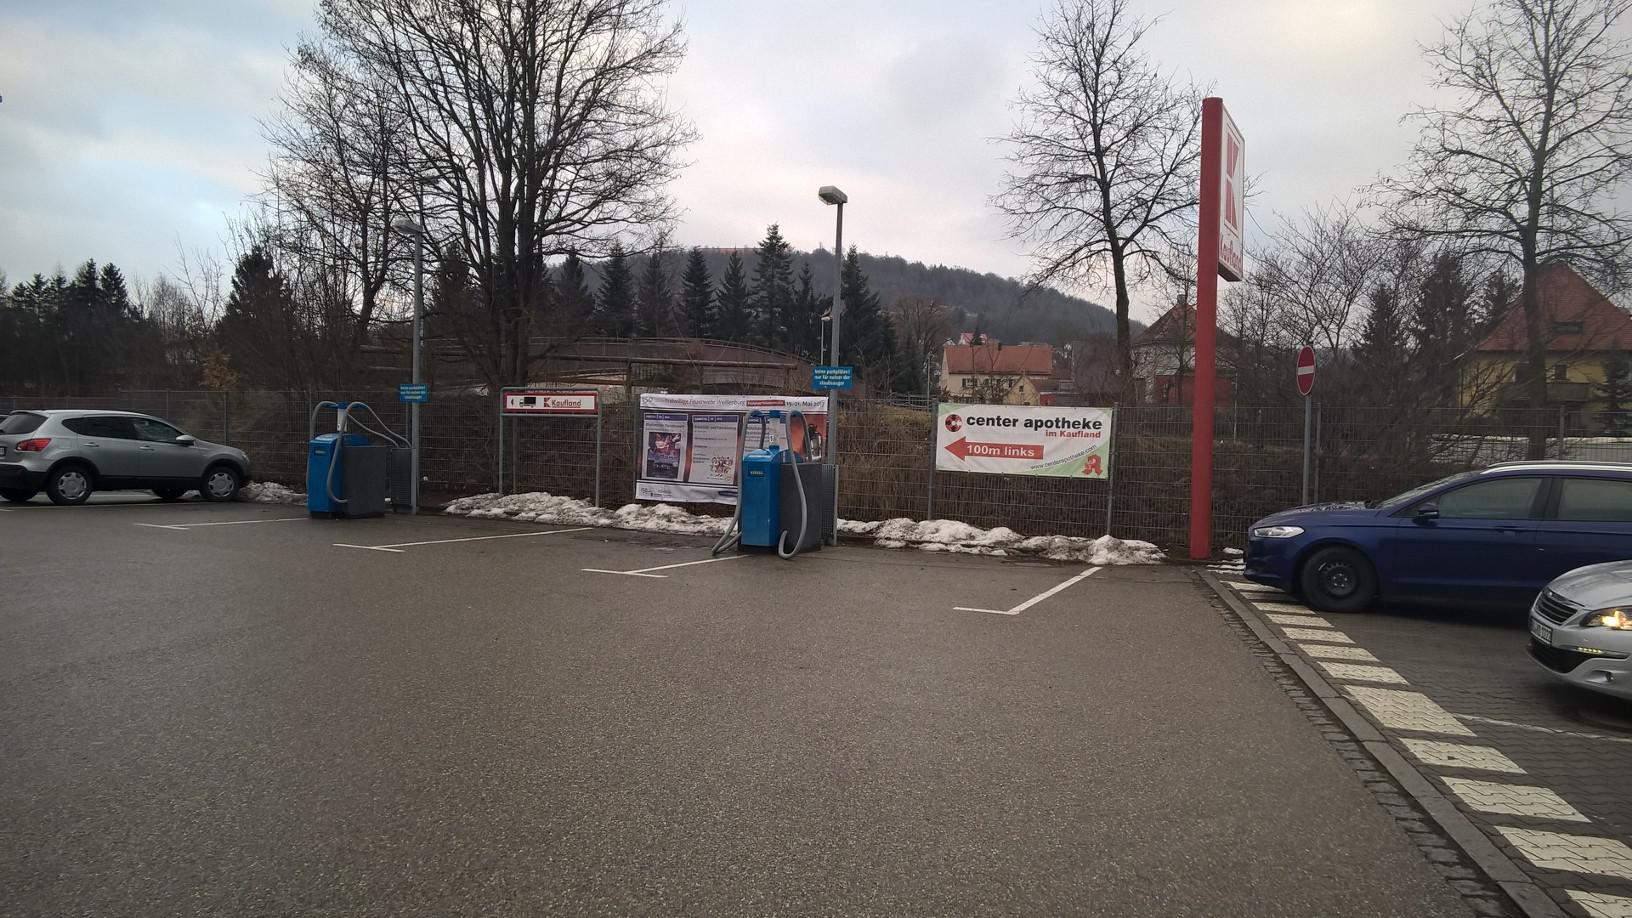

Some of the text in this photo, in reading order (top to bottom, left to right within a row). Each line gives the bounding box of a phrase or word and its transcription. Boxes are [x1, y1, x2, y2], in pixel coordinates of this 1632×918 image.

[551, 399, 582, 408] Kaufland
[966, 416, 1103, 431] center apotheke
[1059, 430, 1101, 439] Kaufland
[967, 445, 1035, 457] 100m links
